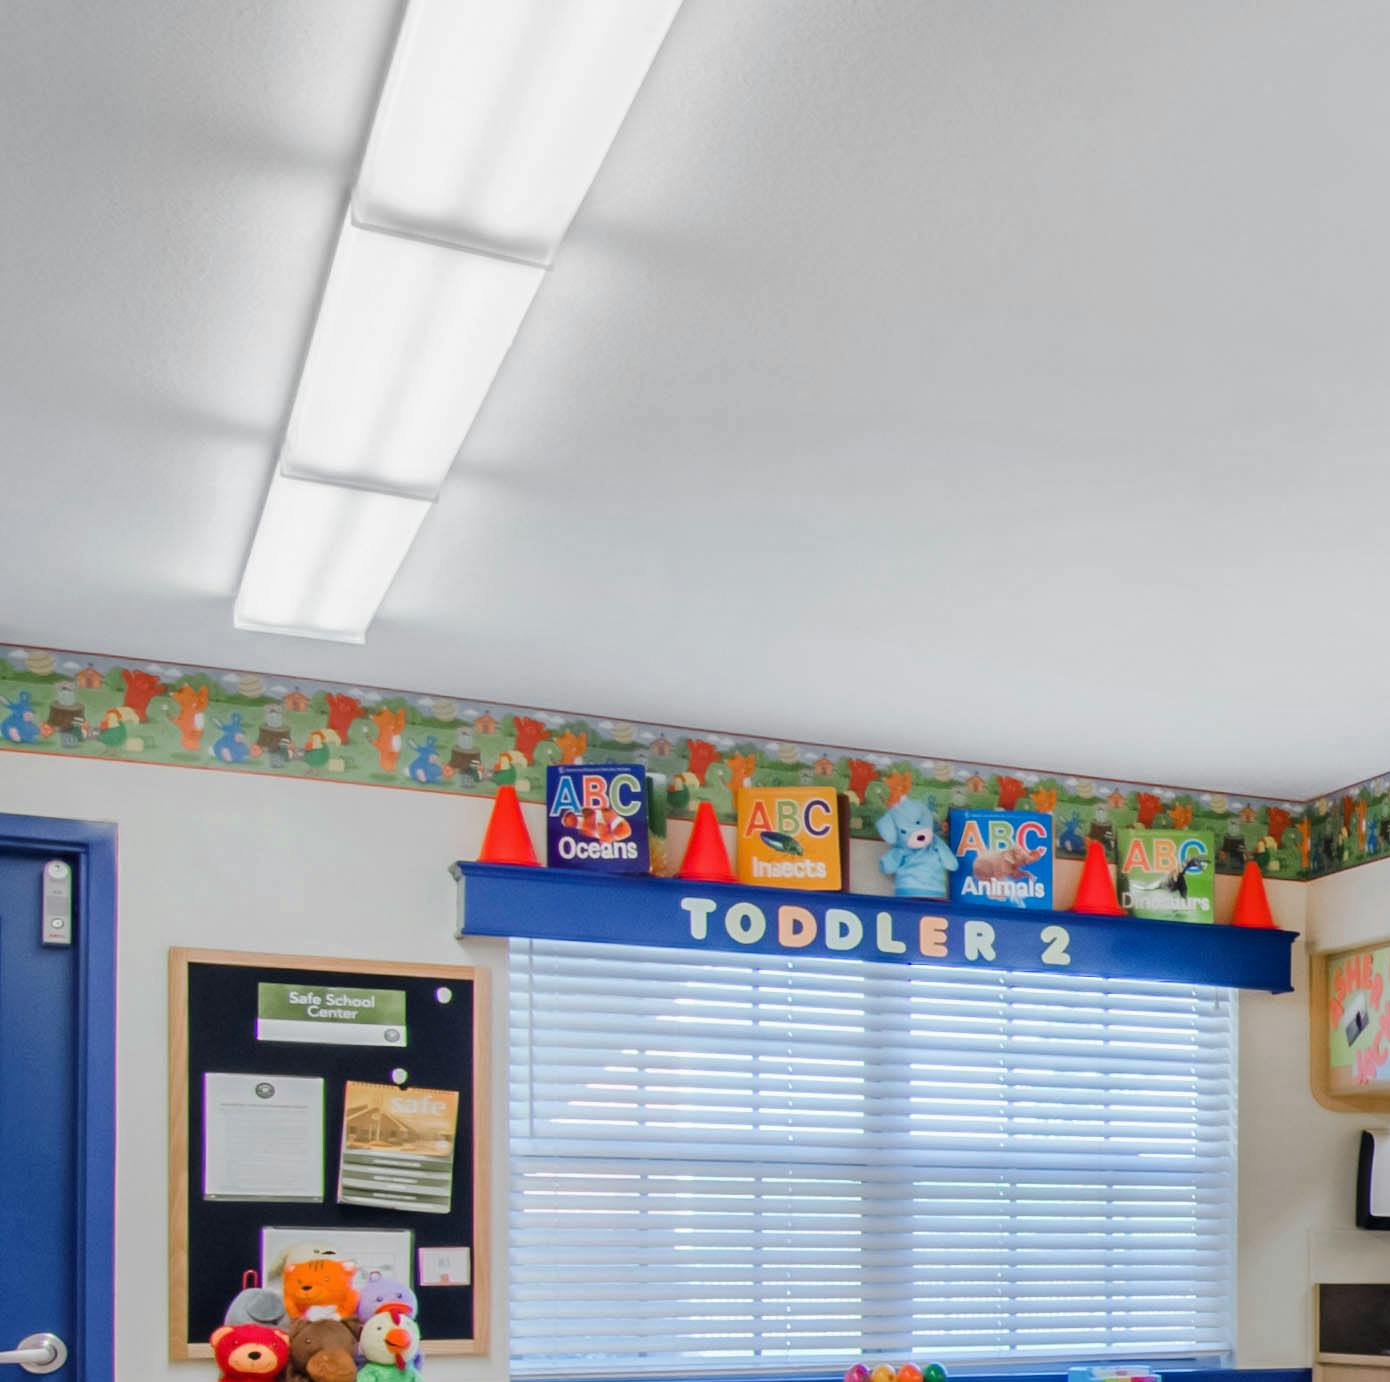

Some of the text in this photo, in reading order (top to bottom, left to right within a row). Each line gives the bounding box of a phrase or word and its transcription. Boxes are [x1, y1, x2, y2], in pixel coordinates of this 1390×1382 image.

[550, 773, 642, 819] ABC
[745, 799, 832, 837] ABC
[559, 836, 638, 860] Oceans
[956, 820, 1048, 857] ABC
[752, 856, 827, 879] Insects
[1122, 839, 1208, 875] ABC
[961, 876, 1046, 899] Animals
[680, 897, 1071, 966] TODDLER 2
[288, 991, 376, 1009] Safe School
[307, 1005, 359, 1019] Center
